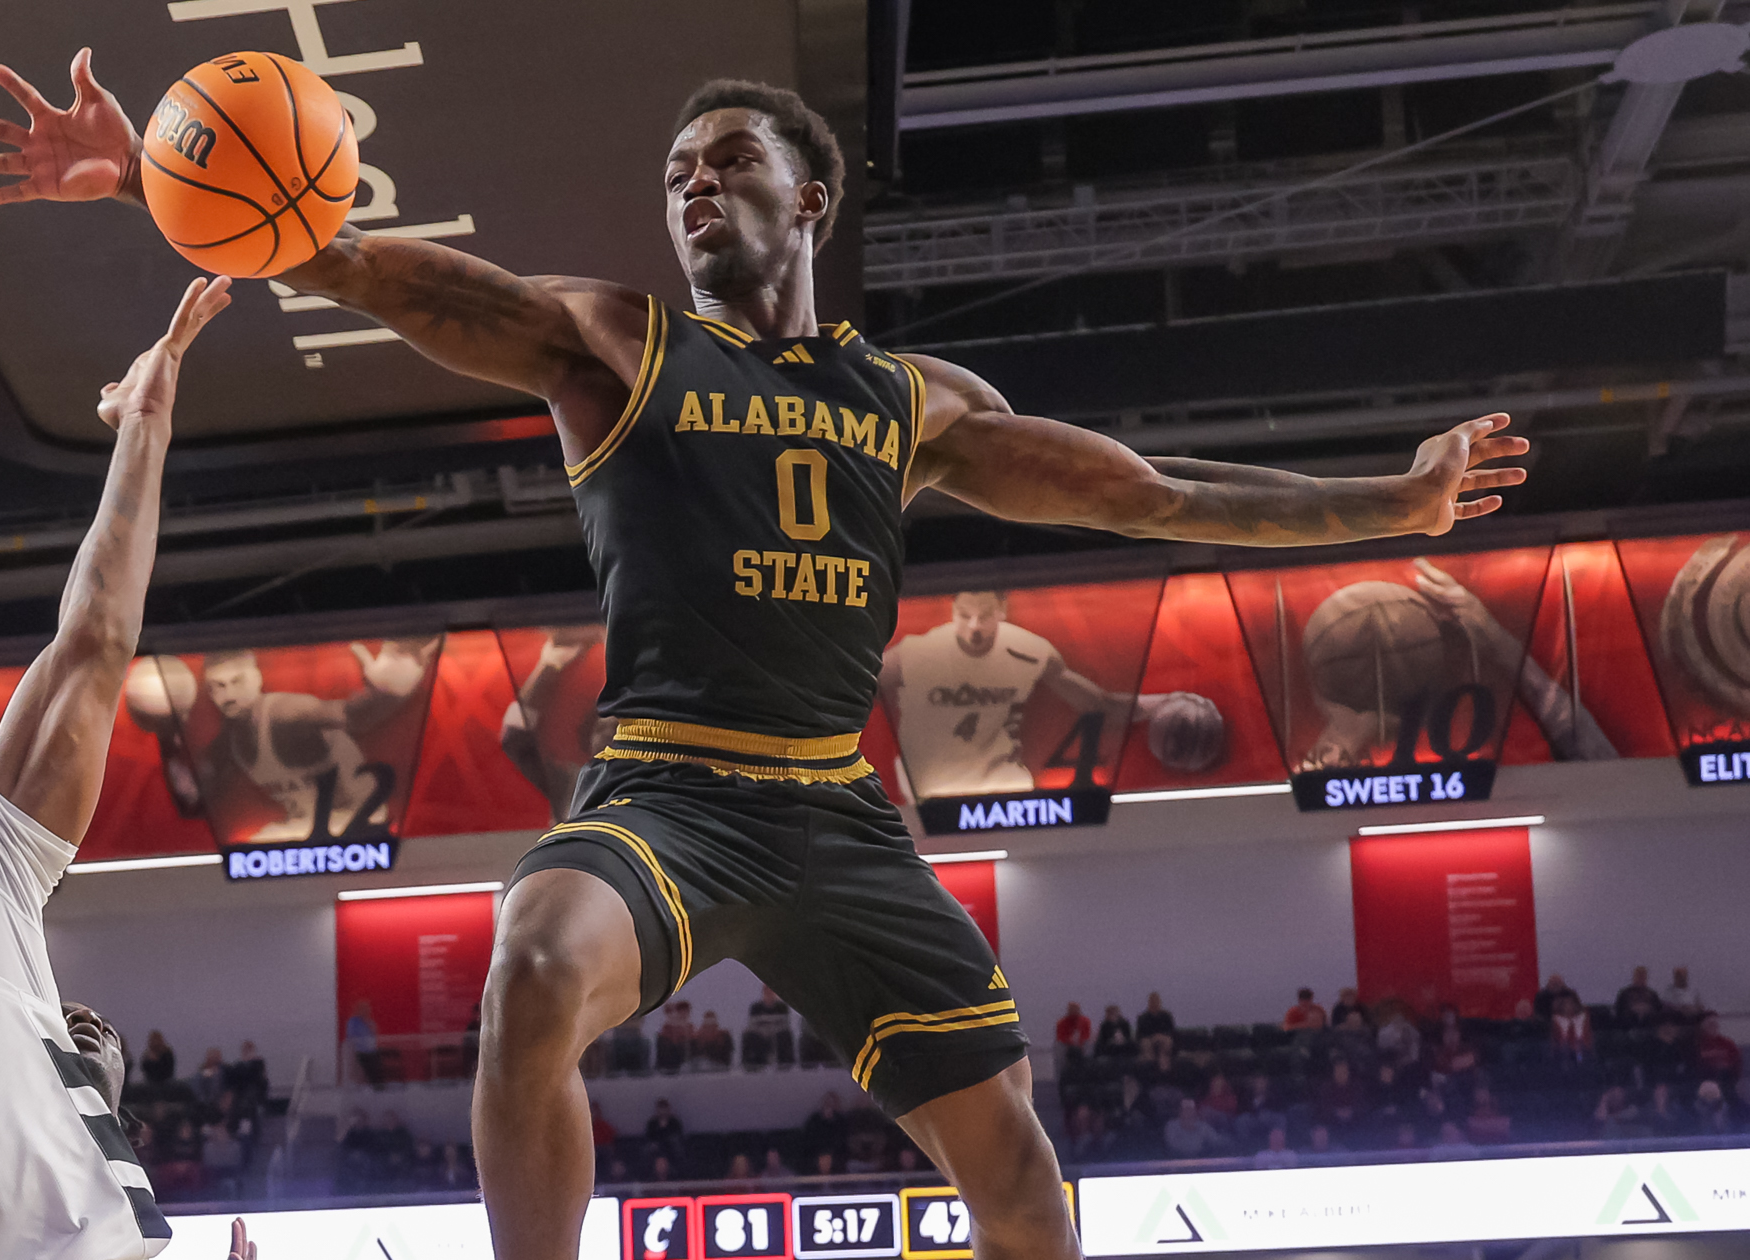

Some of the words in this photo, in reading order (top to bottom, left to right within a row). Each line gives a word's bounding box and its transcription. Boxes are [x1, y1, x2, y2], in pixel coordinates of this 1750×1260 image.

[675, 391, 900, 470] ALABAMA
[775, 449, 831, 541] 0
[733, 549, 870, 608] STATE
[1325, 774, 1423, 807] SWEET
[1430, 771, 1465, 800] 16
[958, 797, 1073, 830] MARTIN
[229, 842, 391, 879] ROBERTSON
[715, 1208, 769, 1252] 81
[813, 1208, 881, 1244] 5:17
[919, 1201, 971, 1244] 47
